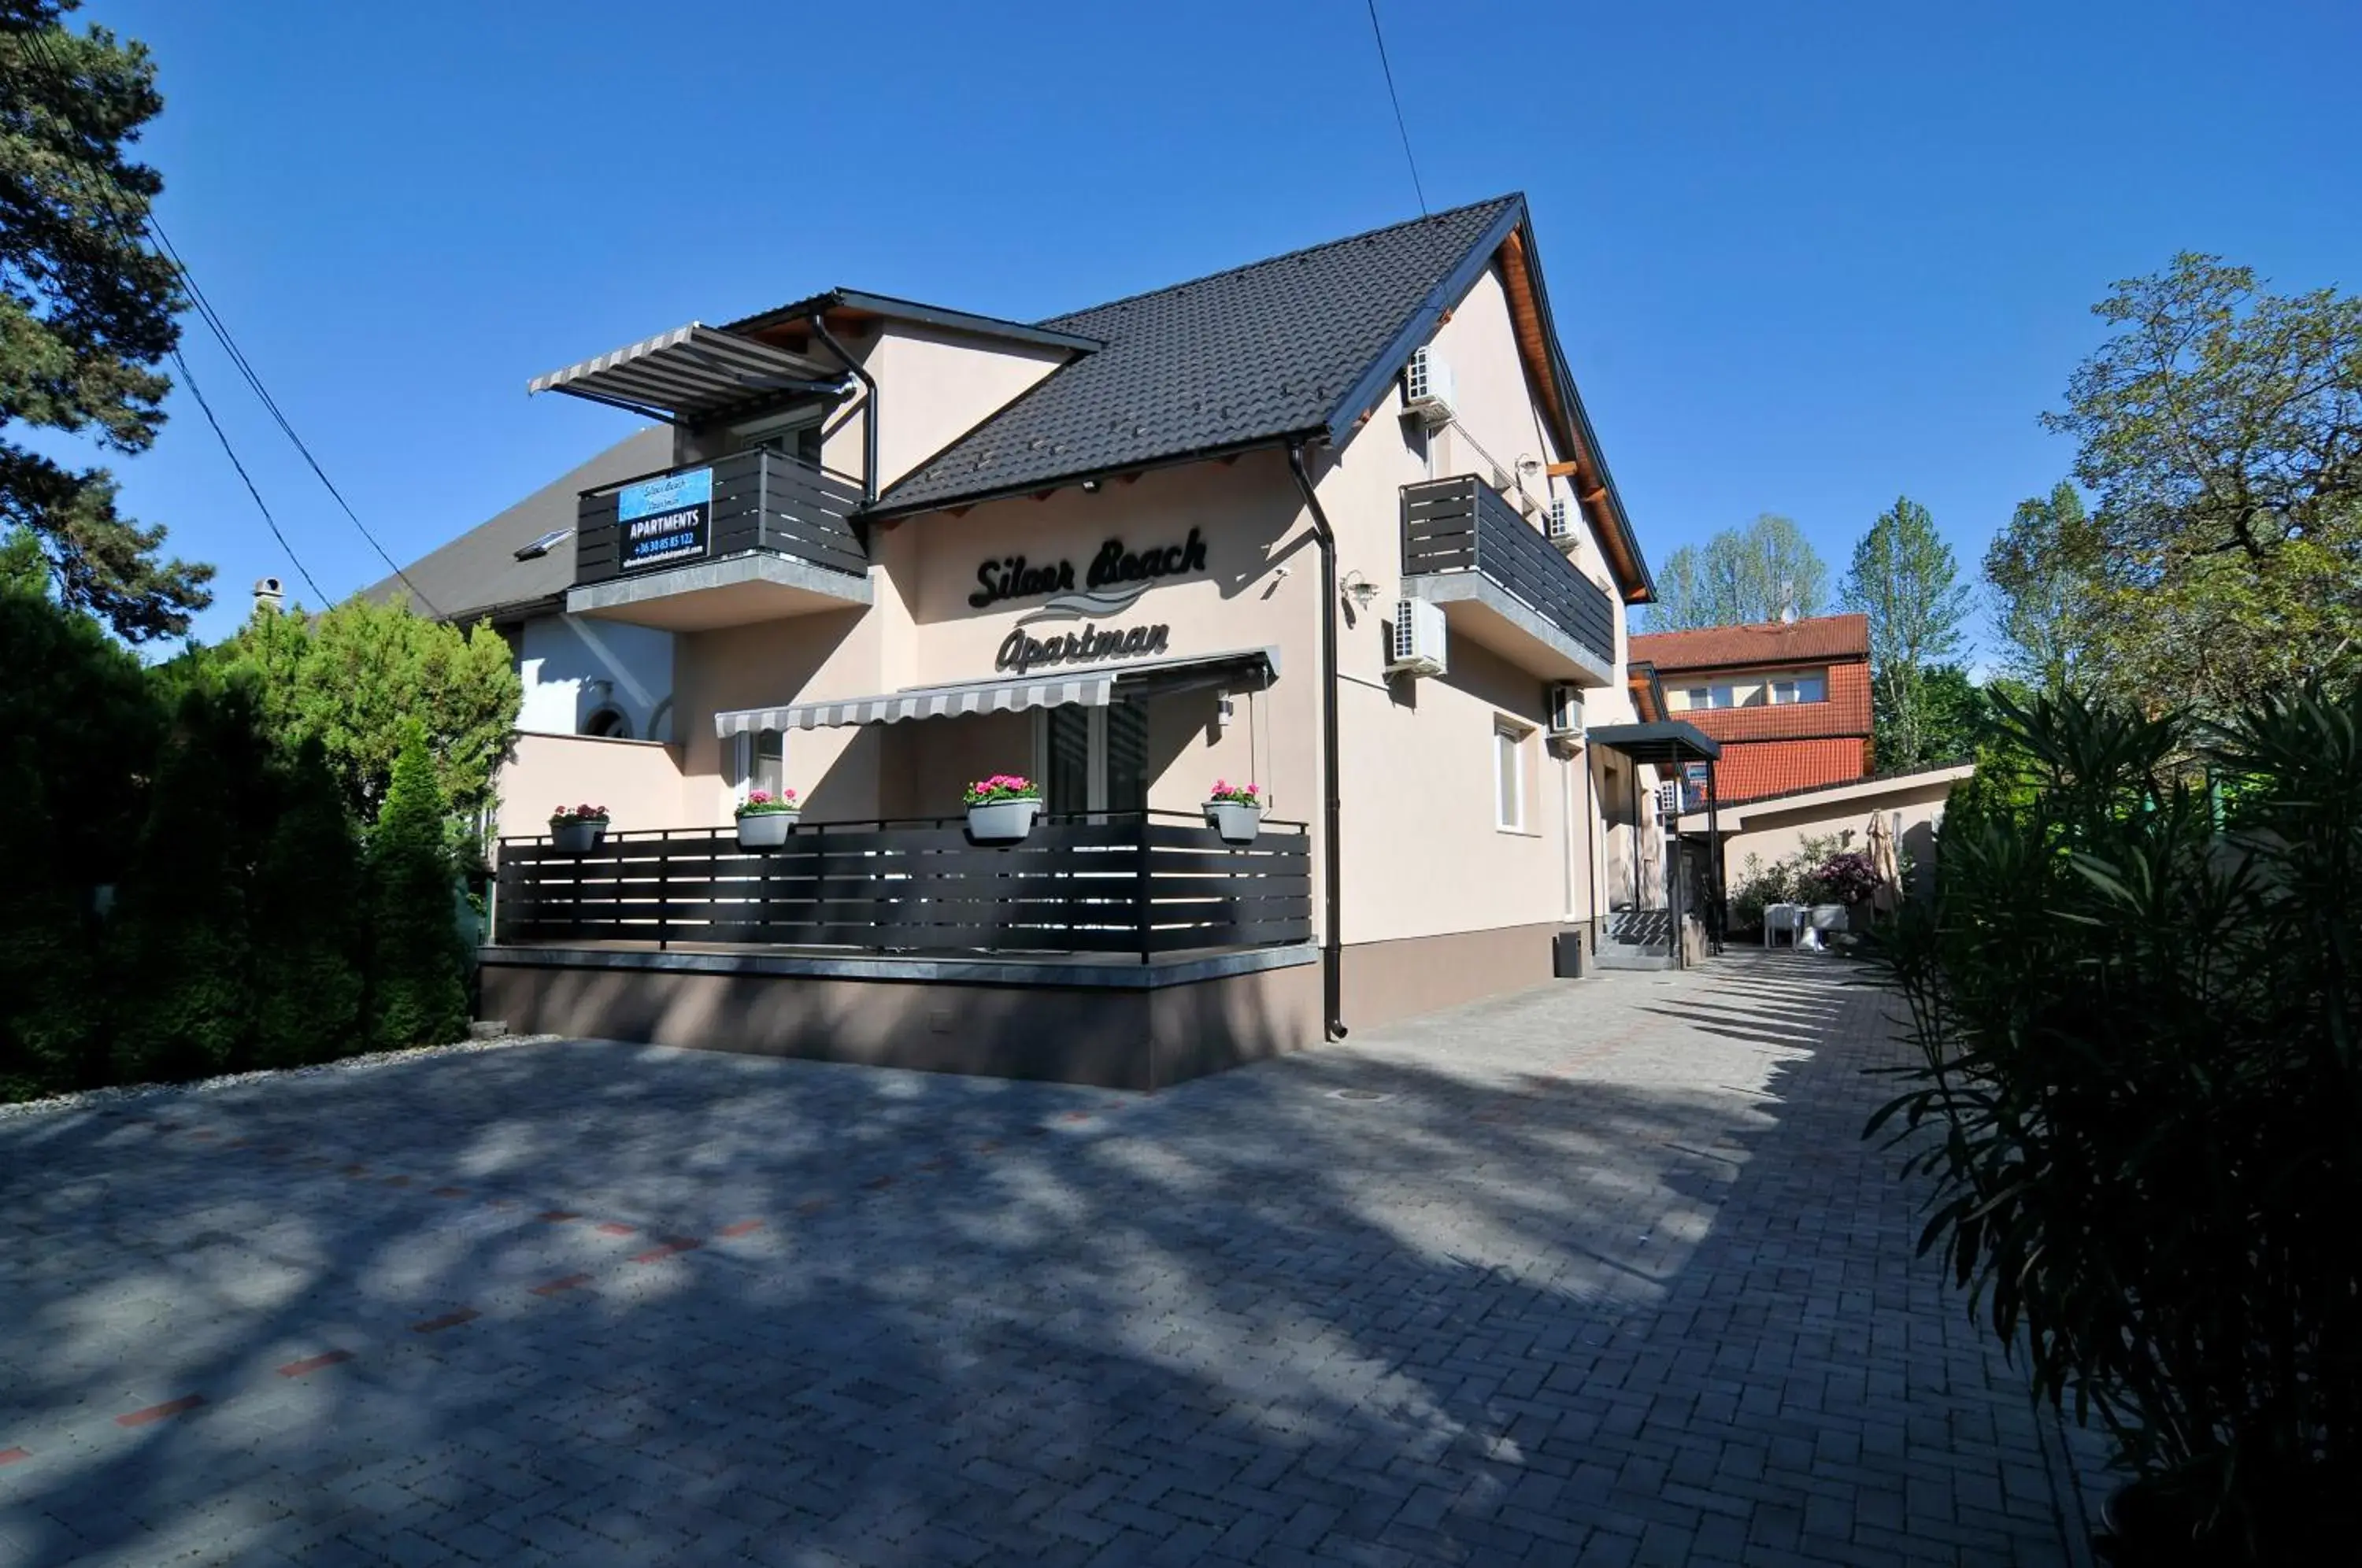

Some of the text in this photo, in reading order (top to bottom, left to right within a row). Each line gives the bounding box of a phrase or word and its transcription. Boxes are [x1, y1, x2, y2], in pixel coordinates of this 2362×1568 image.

[630, 509, 699, 540] APARTMENTS
[968, 525, 1208, 608] Silver Beach
[995, 623, 1170, 674] Apartman
